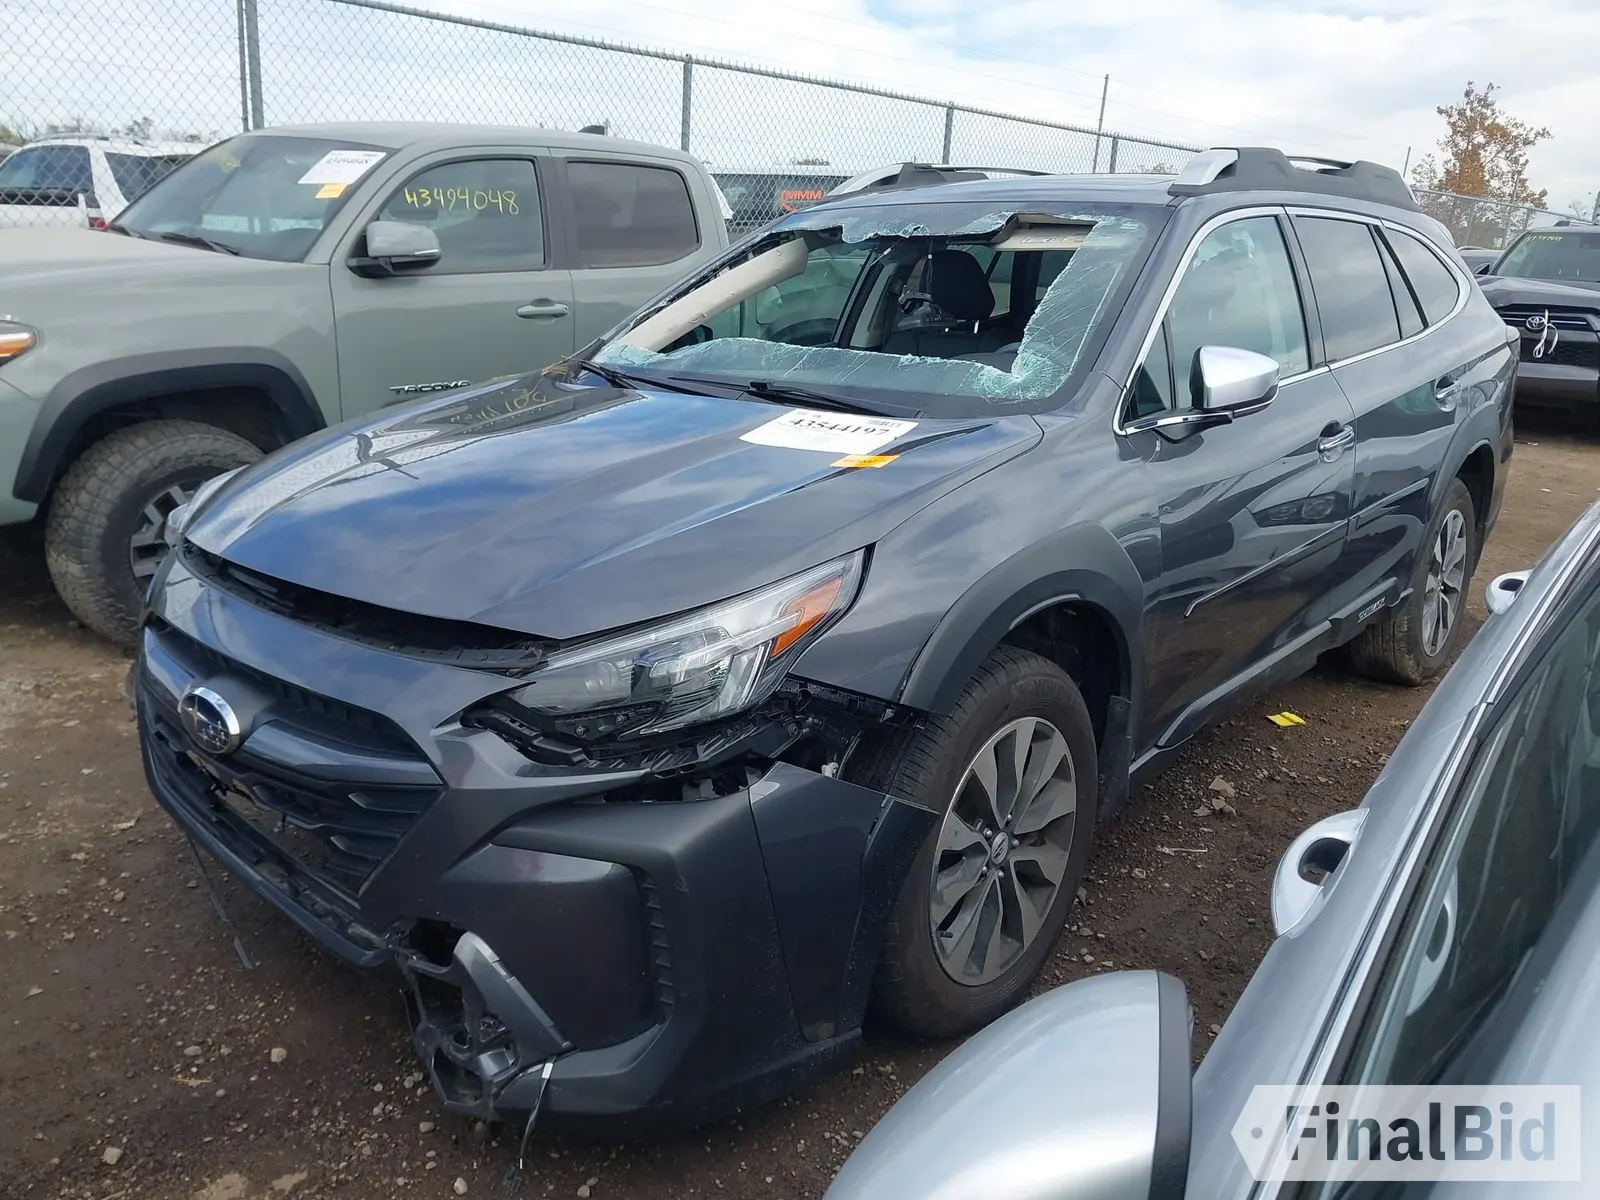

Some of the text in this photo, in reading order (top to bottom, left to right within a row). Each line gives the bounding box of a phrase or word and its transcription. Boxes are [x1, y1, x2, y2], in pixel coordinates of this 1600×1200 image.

[404, 187, 519, 215] 43494048
[390, 380, 471, 394] TACOMA
[790, 418, 890, 436] 43544197
